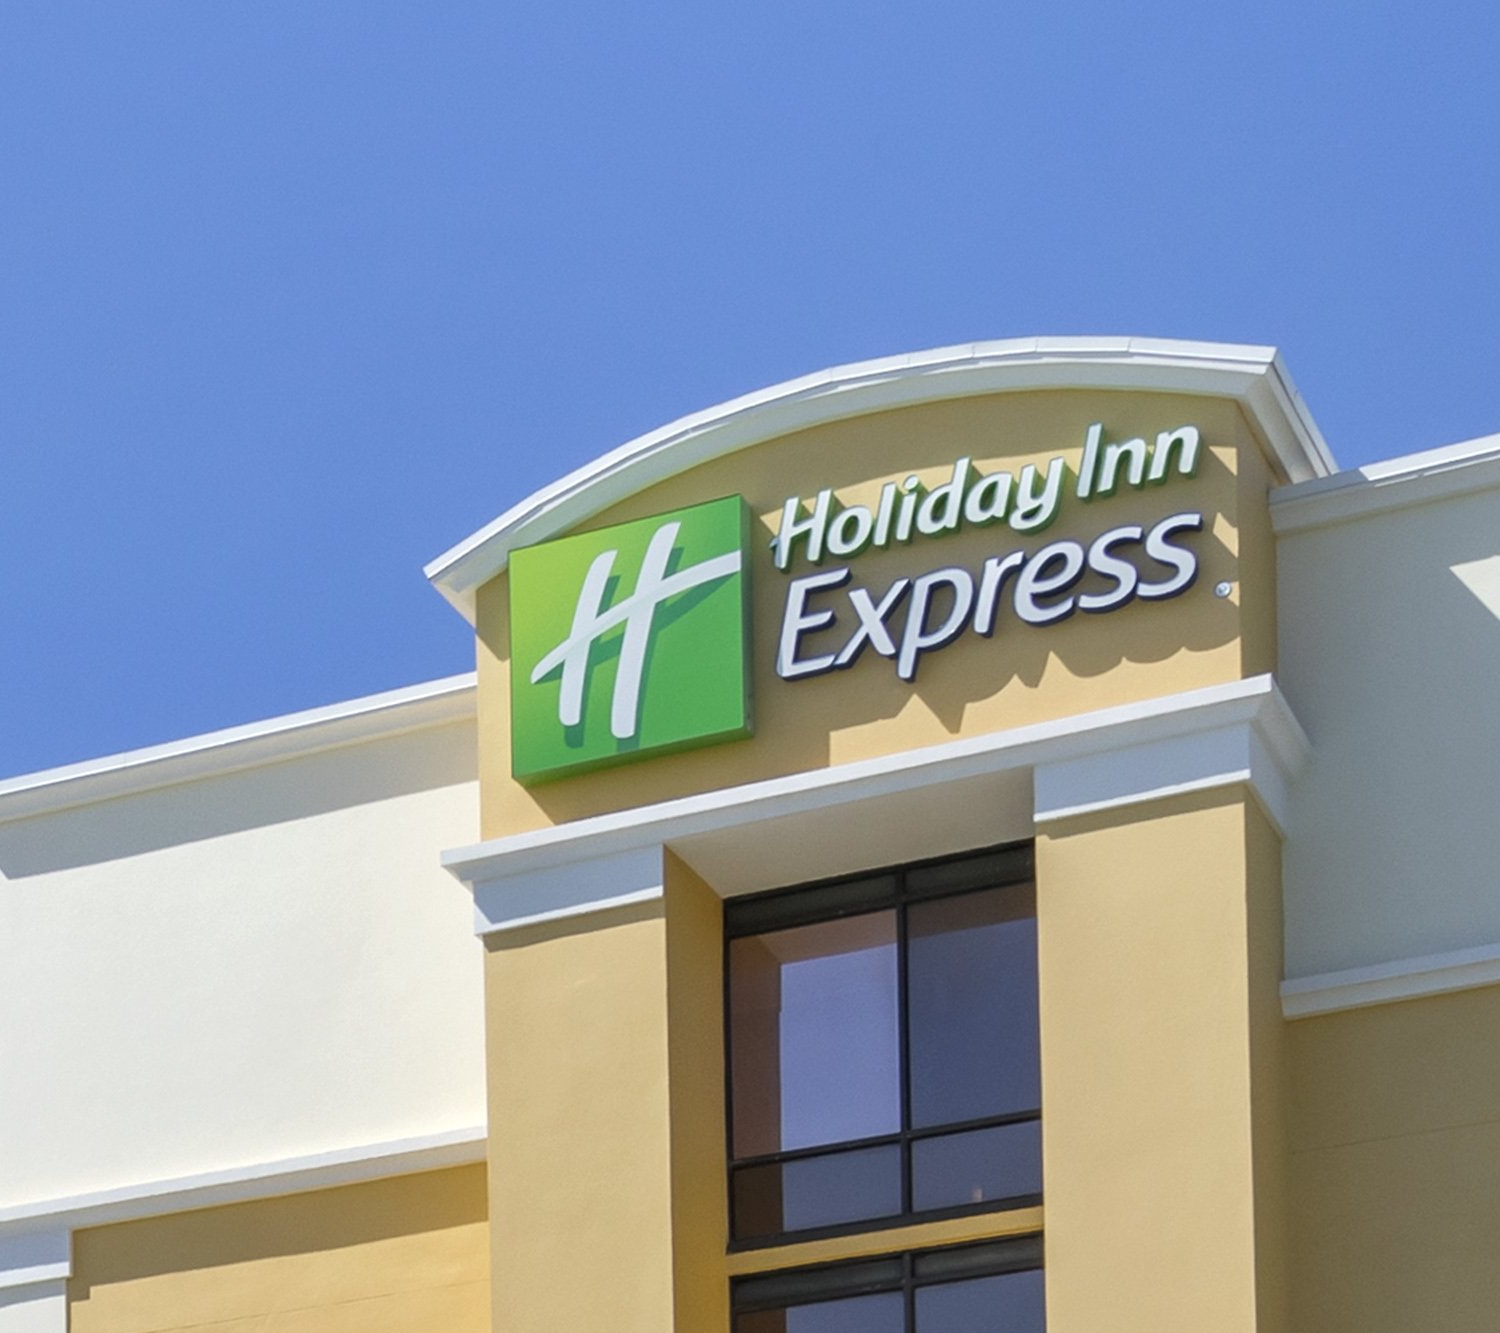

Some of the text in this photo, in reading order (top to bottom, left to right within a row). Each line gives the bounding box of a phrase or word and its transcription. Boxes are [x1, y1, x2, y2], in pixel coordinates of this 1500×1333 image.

[775, 421, 1200, 570] Holiday Inn
[775, 512, 1202, 682] Express
